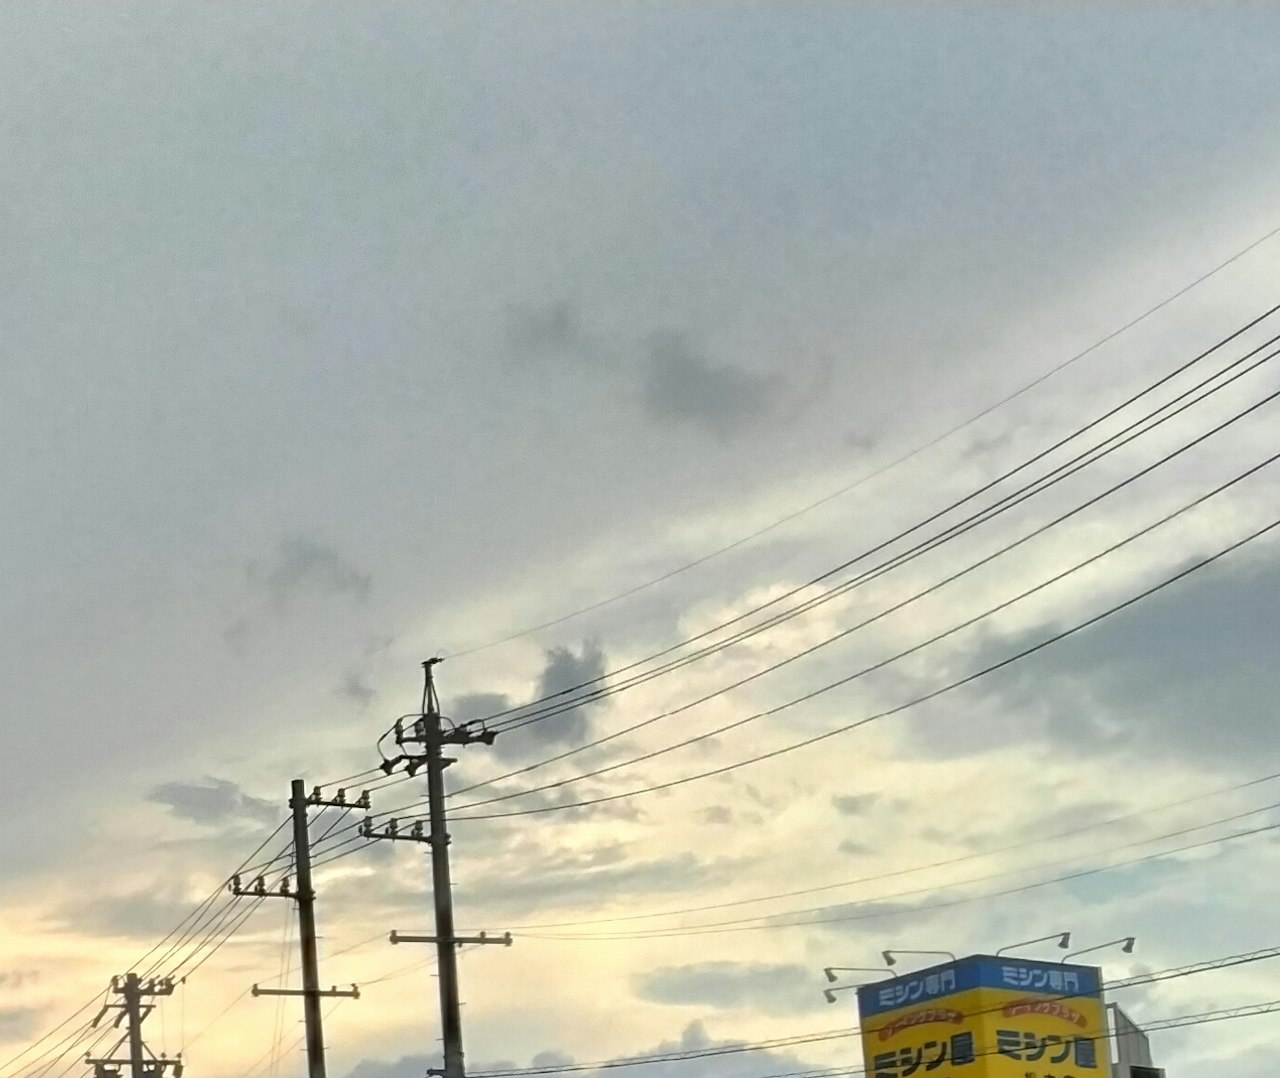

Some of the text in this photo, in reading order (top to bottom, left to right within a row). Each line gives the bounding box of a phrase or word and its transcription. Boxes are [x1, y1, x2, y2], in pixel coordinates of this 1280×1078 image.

[878, 969, 956, 1006] ミシン専門
[1001, 966, 1080, 993] ミシン専門
